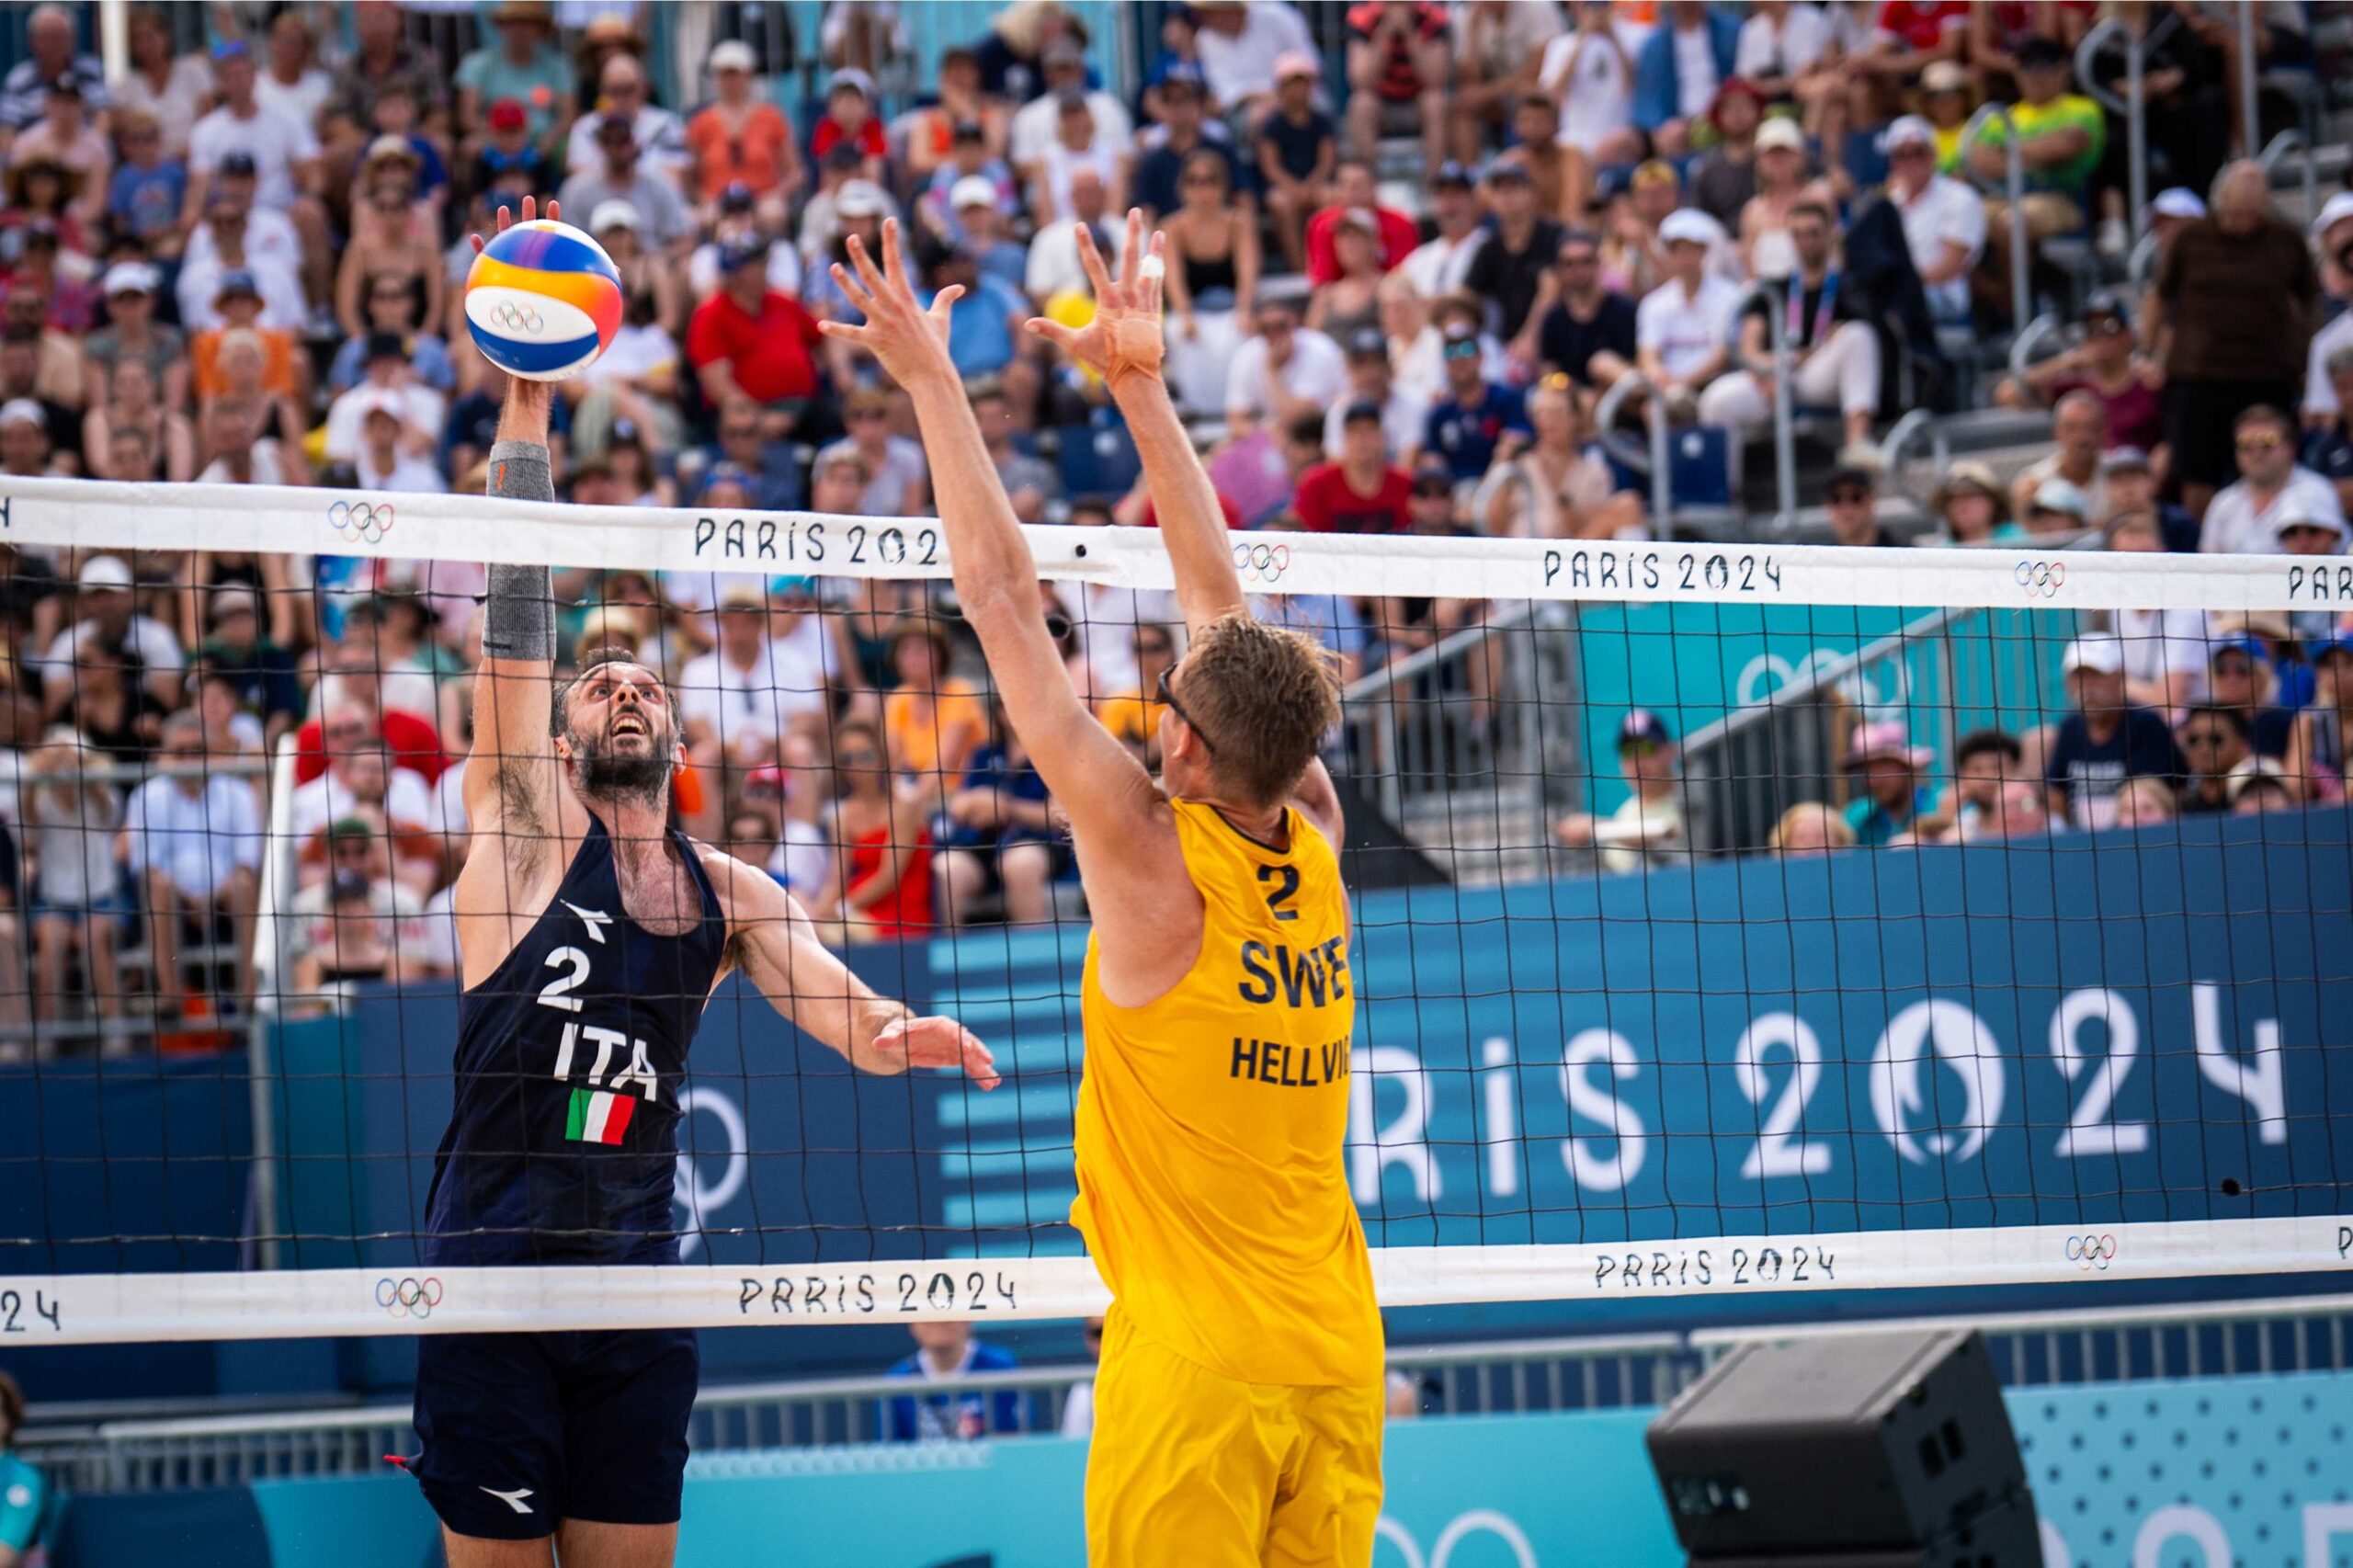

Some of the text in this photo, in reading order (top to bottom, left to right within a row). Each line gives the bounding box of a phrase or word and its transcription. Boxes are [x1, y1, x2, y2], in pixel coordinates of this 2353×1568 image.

[1678, 553, 1781, 592] 2024
[1256, 864, 1300, 920] 2
[537, 946, 590, 1013] 2
[1238, 936, 1347, 1008] SWE
[553, 1022, 658, 1101] ITA
[1734, 980, 2288, 1179] 2024
[898, 1272, 1017, 1312] 2024
[1733, 1245, 1835, 1286] 2024
